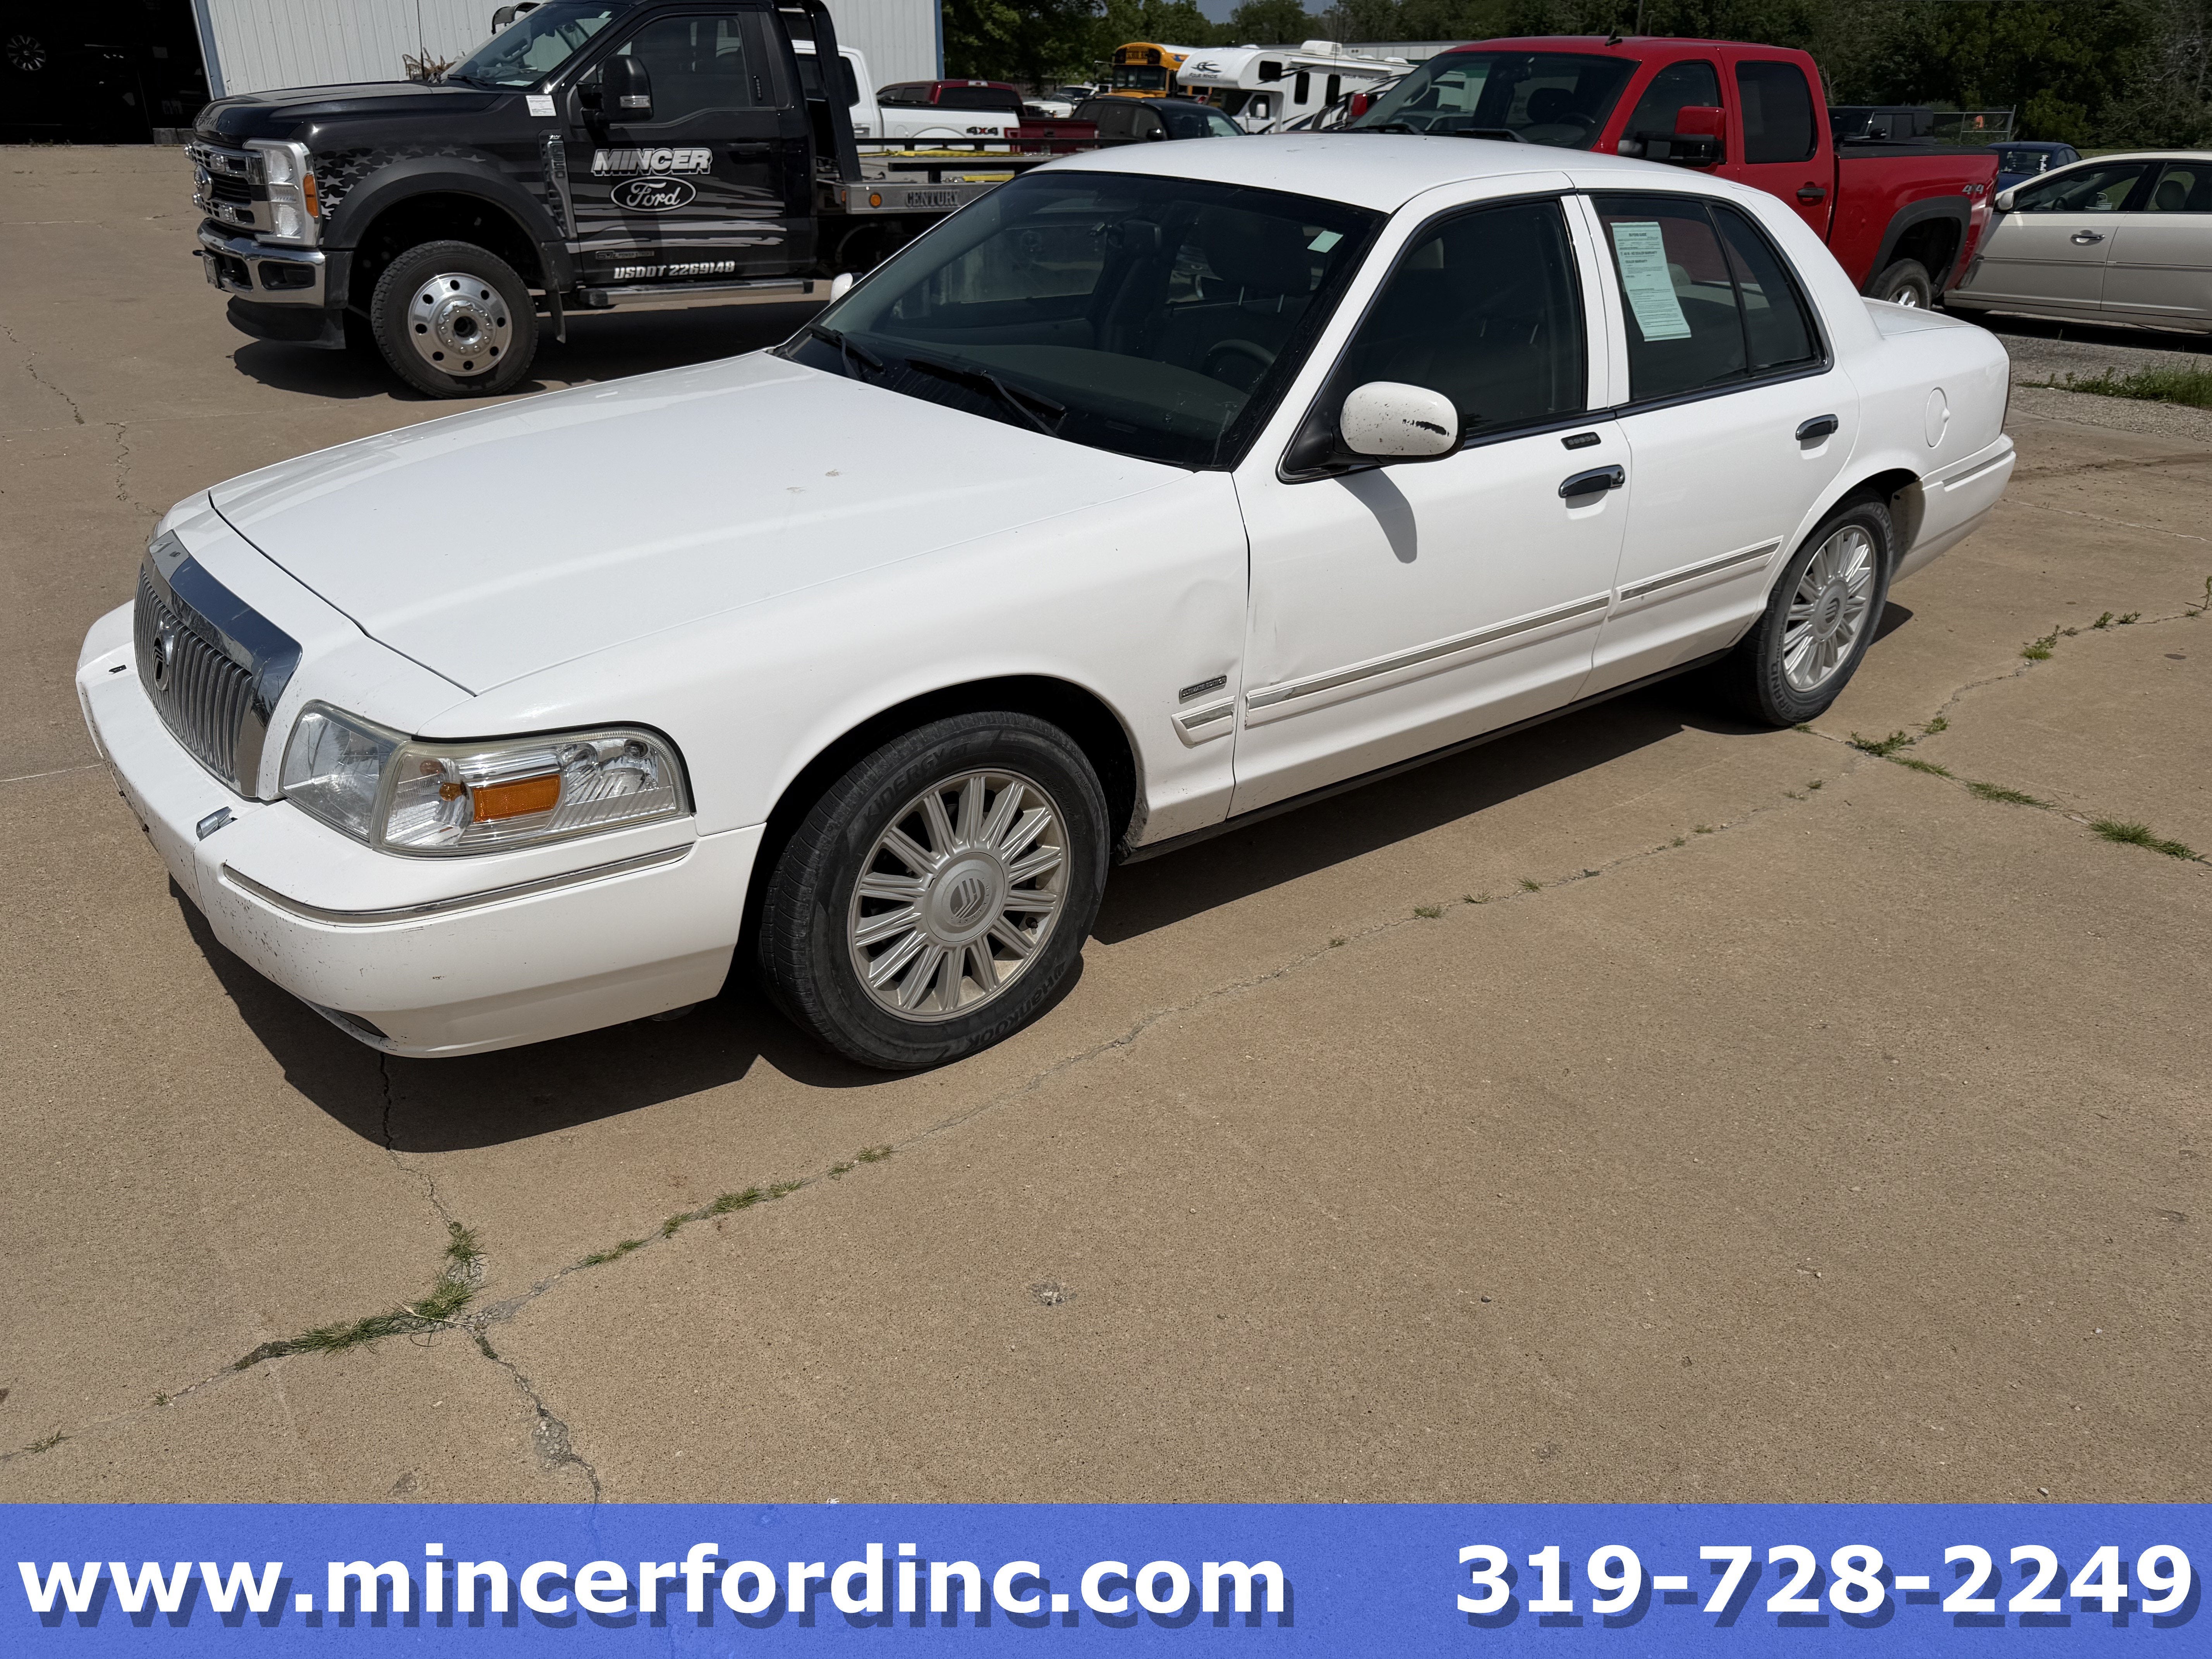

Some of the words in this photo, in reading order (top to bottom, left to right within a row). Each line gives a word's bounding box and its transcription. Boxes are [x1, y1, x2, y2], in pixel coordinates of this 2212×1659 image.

[591, 149, 712, 175] MINCER
[626, 182, 682, 206] Ford
[905, 189, 960, 207] CENTURY
[613, 265, 666, 279] USDOT
[668, 261, 735, 276] 2269148
